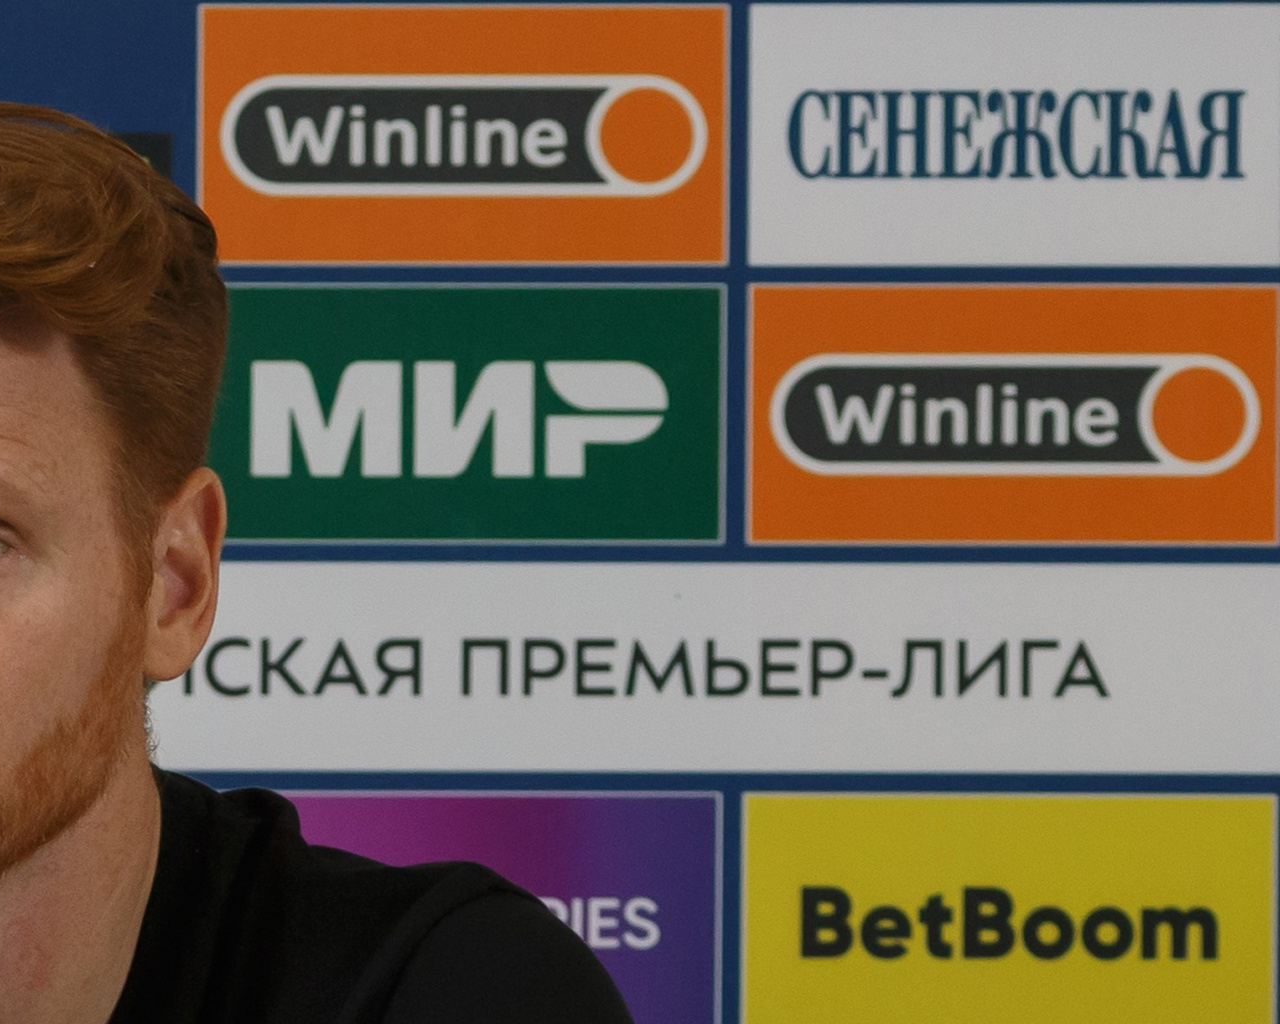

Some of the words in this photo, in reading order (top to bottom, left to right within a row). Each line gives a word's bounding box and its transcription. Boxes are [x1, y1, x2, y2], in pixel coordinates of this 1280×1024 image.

[267, 105, 567, 167] Winline
[788, 89, 1246, 180] СЕНЕЖСКАЯ
[250, 361, 668, 478] МИР
[817, 384, 1119, 446] Winline
[462, 638, 1109, 698] ПРЕМЬЕР-ЛИГА
[800, 886, 1218, 961] BetBoom
